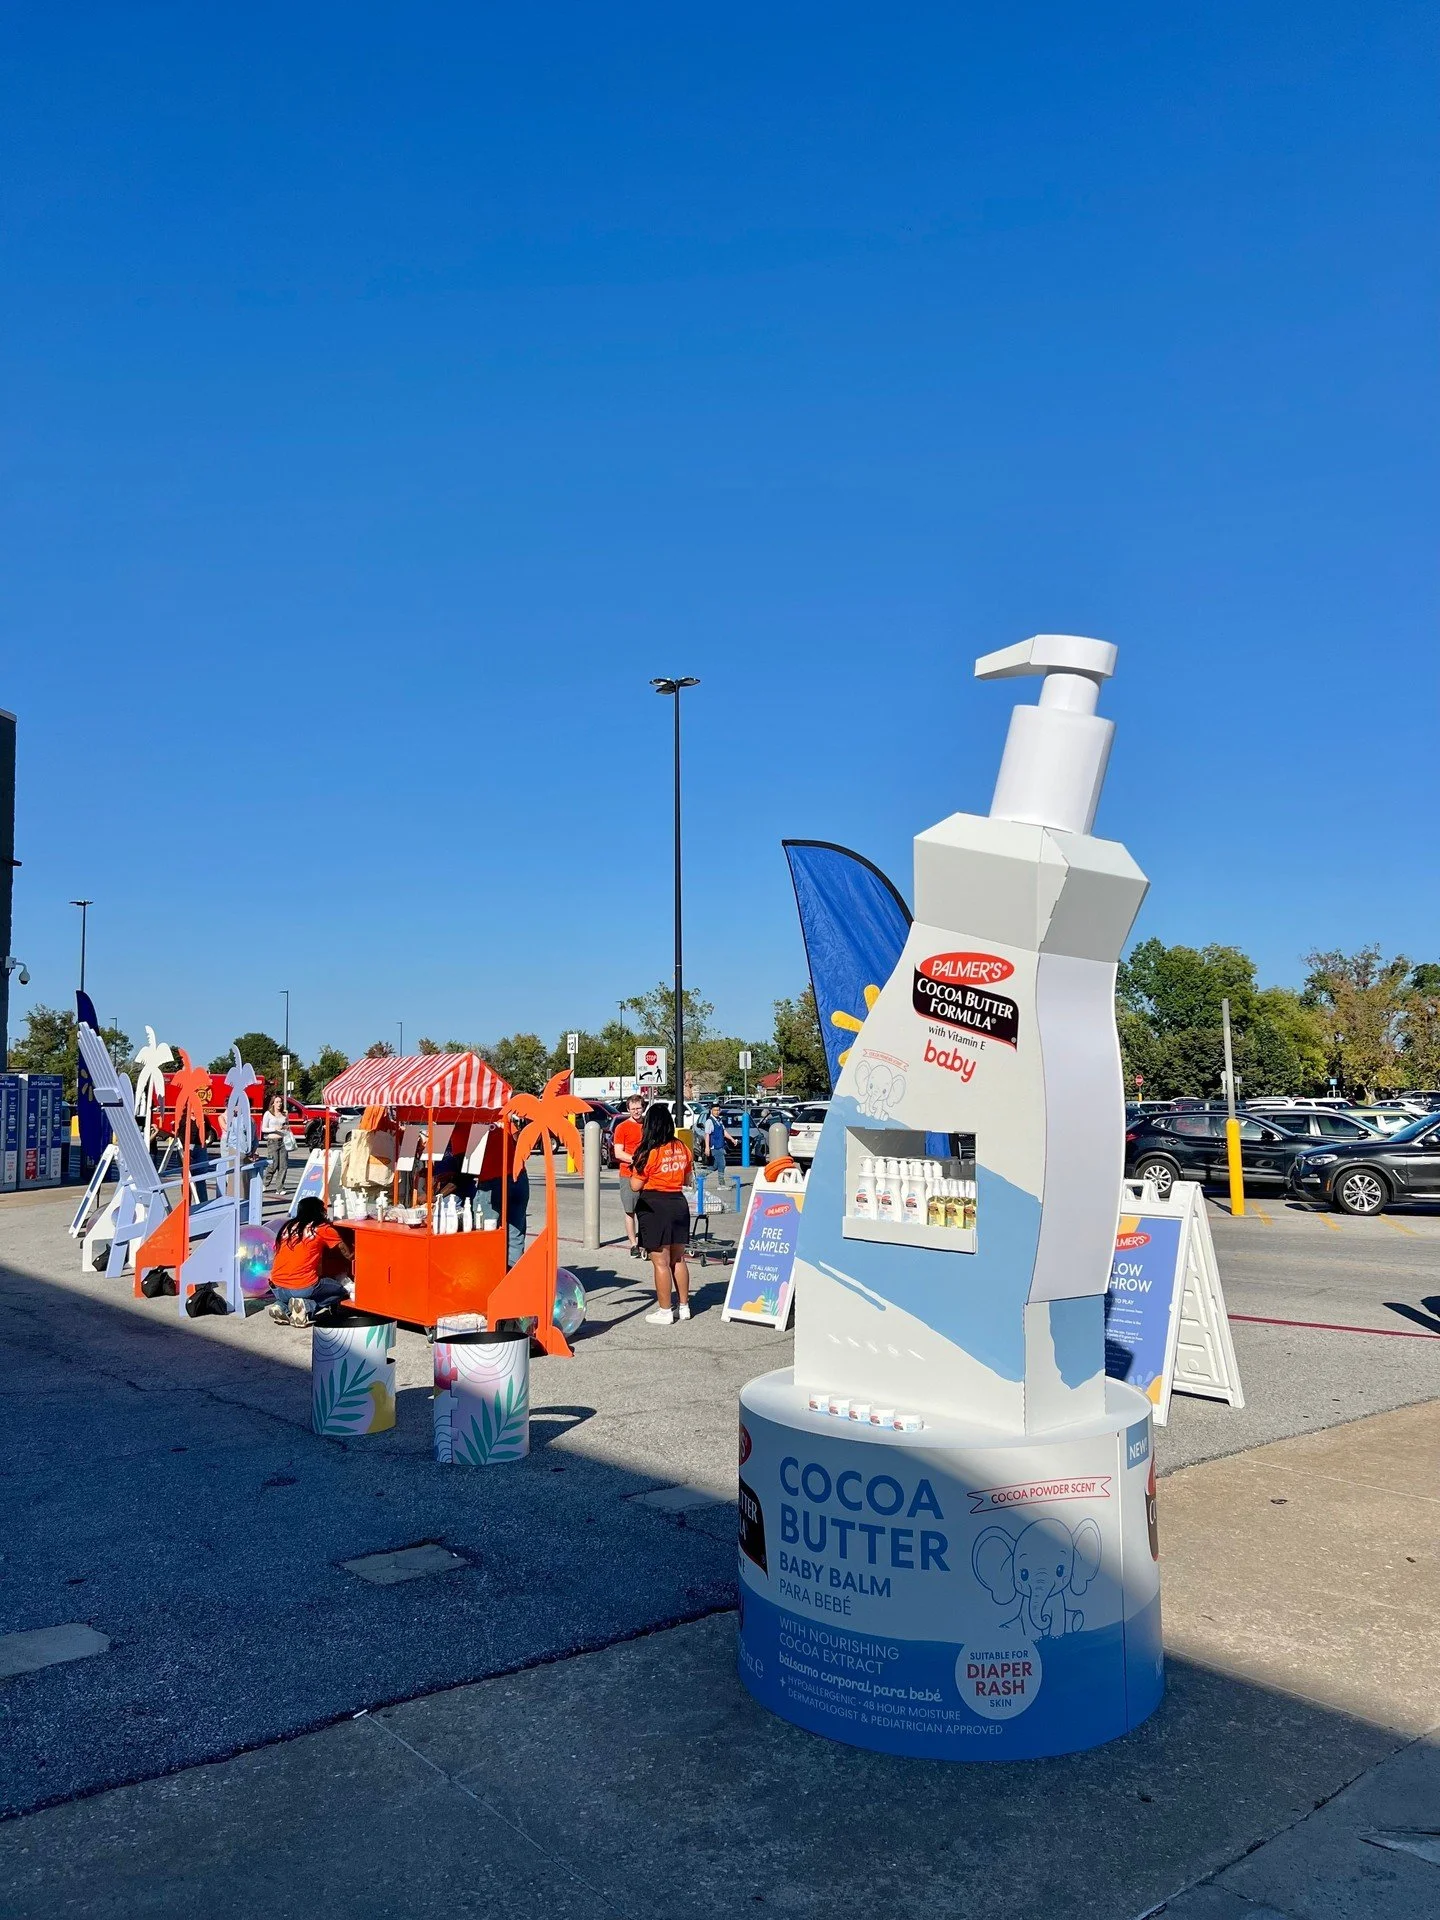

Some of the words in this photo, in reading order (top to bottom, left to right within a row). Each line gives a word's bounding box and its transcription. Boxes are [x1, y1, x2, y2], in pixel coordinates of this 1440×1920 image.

[932, 960, 1003, 982] PALMER'S
[917, 978, 962, 1004] COCOA
[965, 991, 1014, 1019] BUTTER
[928, 1025, 946, 1037] with
[948, 1029, 978, 1048] Vitamin
[980, 1041, 987, 1050] E
[923, 1039, 977, 1083] baby
[761, 1227, 783, 1240] FREE
[1116, 1235, 1145, 1247] LMER'S
[749, 1239, 790, 1254] SAMPLES
[746, 1270, 758, 1280] THE
[758, 1272, 779, 1282] GLOW
[1113, 1262, 1144, 1277] LOW
[1109, 1277, 1153, 1293] HROW
[1129, 1437, 1148, 1461] NEW!
[779, 1456, 944, 1520] COCOA
[991, 1489, 1028, 1504] COCOA
[1030, 1483, 1070, 1497] POWDER
[1071, 1482, 1096, 1493] SCENT
[739, 1489, 758, 1524] TTER
[780, 1503, 951, 1572] BUTTER
[779, 1551, 824, 1583] BABY
[829, 1567, 891, 1597] BALM
[779, 1578, 812, 1605] PARA
[815, 1586, 852, 1616] BEBÉ
[779, 1615, 806, 1636] WITH
[809, 1628, 900, 1660] NOURISHING
[779, 1632, 820, 1660] COCOA
[823, 1649, 884, 1675] EXTRACT
[969, 1651, 1010, 1661] SUITABLE
[1011, 1650, 1029, 1659] FOR
[967, 1661, 1033, 1679] DIAPER
[788, 1675, 857, 1707] HYPOALLERGENIC
[862, 1699, 875, 1710] 48
[877, 1702, 907, 1716] HOUR
[908, 1706, 961, 1721] MOISTURE
[820, 1671, 872, 1693] corporal
[873, 1685, 908, 1699] para
[909, 1687, 943, 1702] bebé
[975, 1679, 1025, 1697] RASH
[788, 1687, 859, 1720] DERMATOLOGIST
[861, 1713, 868, 1723] &
[871, 1715, 943, 1734] PEDIATRICIAN
[945, 1724, 1003, 1735] APPROVED
[989, 1698, 1012, 1708] SKIN
